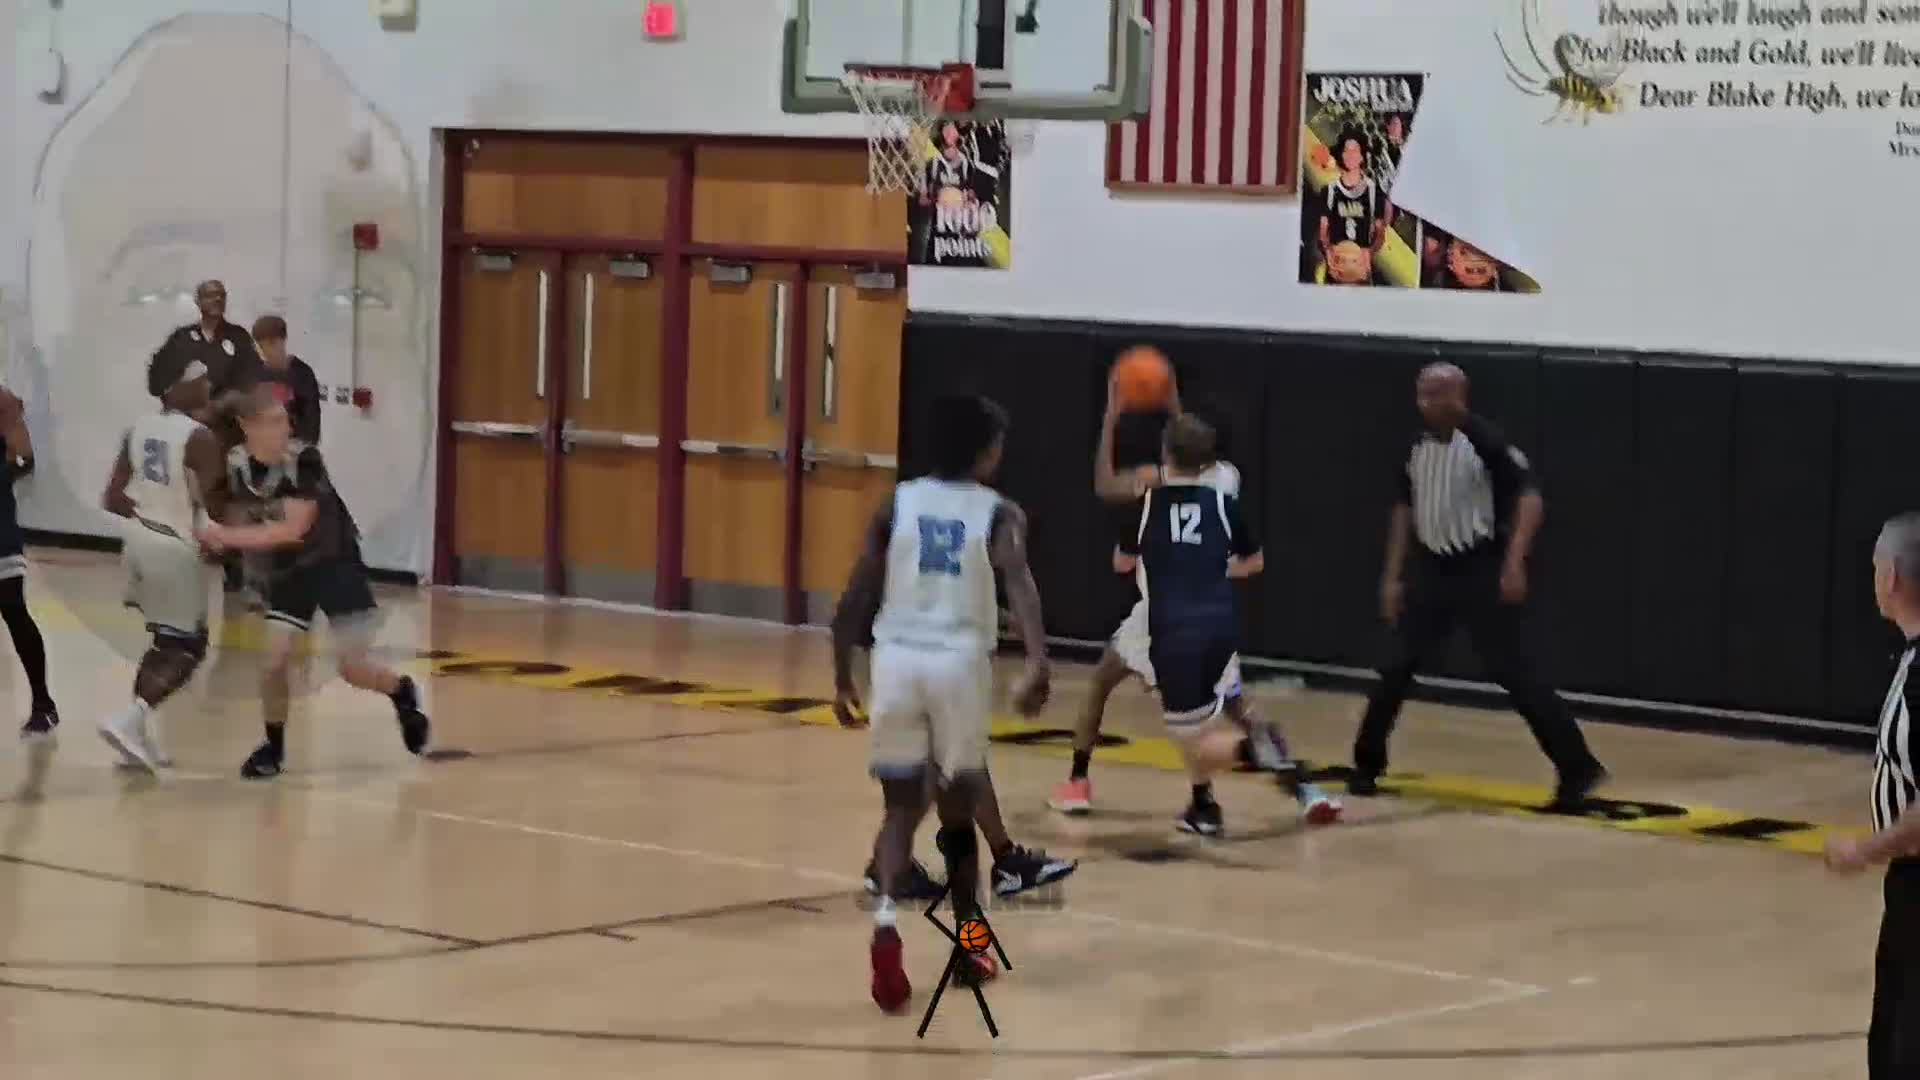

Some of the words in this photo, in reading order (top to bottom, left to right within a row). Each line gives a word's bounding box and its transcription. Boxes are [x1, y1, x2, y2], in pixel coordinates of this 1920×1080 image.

[1687, 0, 1738, 25] we'll
[1747, 0, 1811, 30] laugh
[1820, 0, 1868, 24] and
[1622, 39, 1686, 63] Black
[1696, 39, 1741, 63] and
[1749, 39, 1811, 66] Gold,
[1820, 39, 1875, 65] we'll
[1313, 76, 1414, 102] JOSHUA
[1639, 81, 1699, 107] Dear
[1707, 81, 1775, 107] Blake
[1784, 80, 1847, 114] High,
[1856, 90, 1890, 107] we
[1170, 503, 1202, 545] 12
